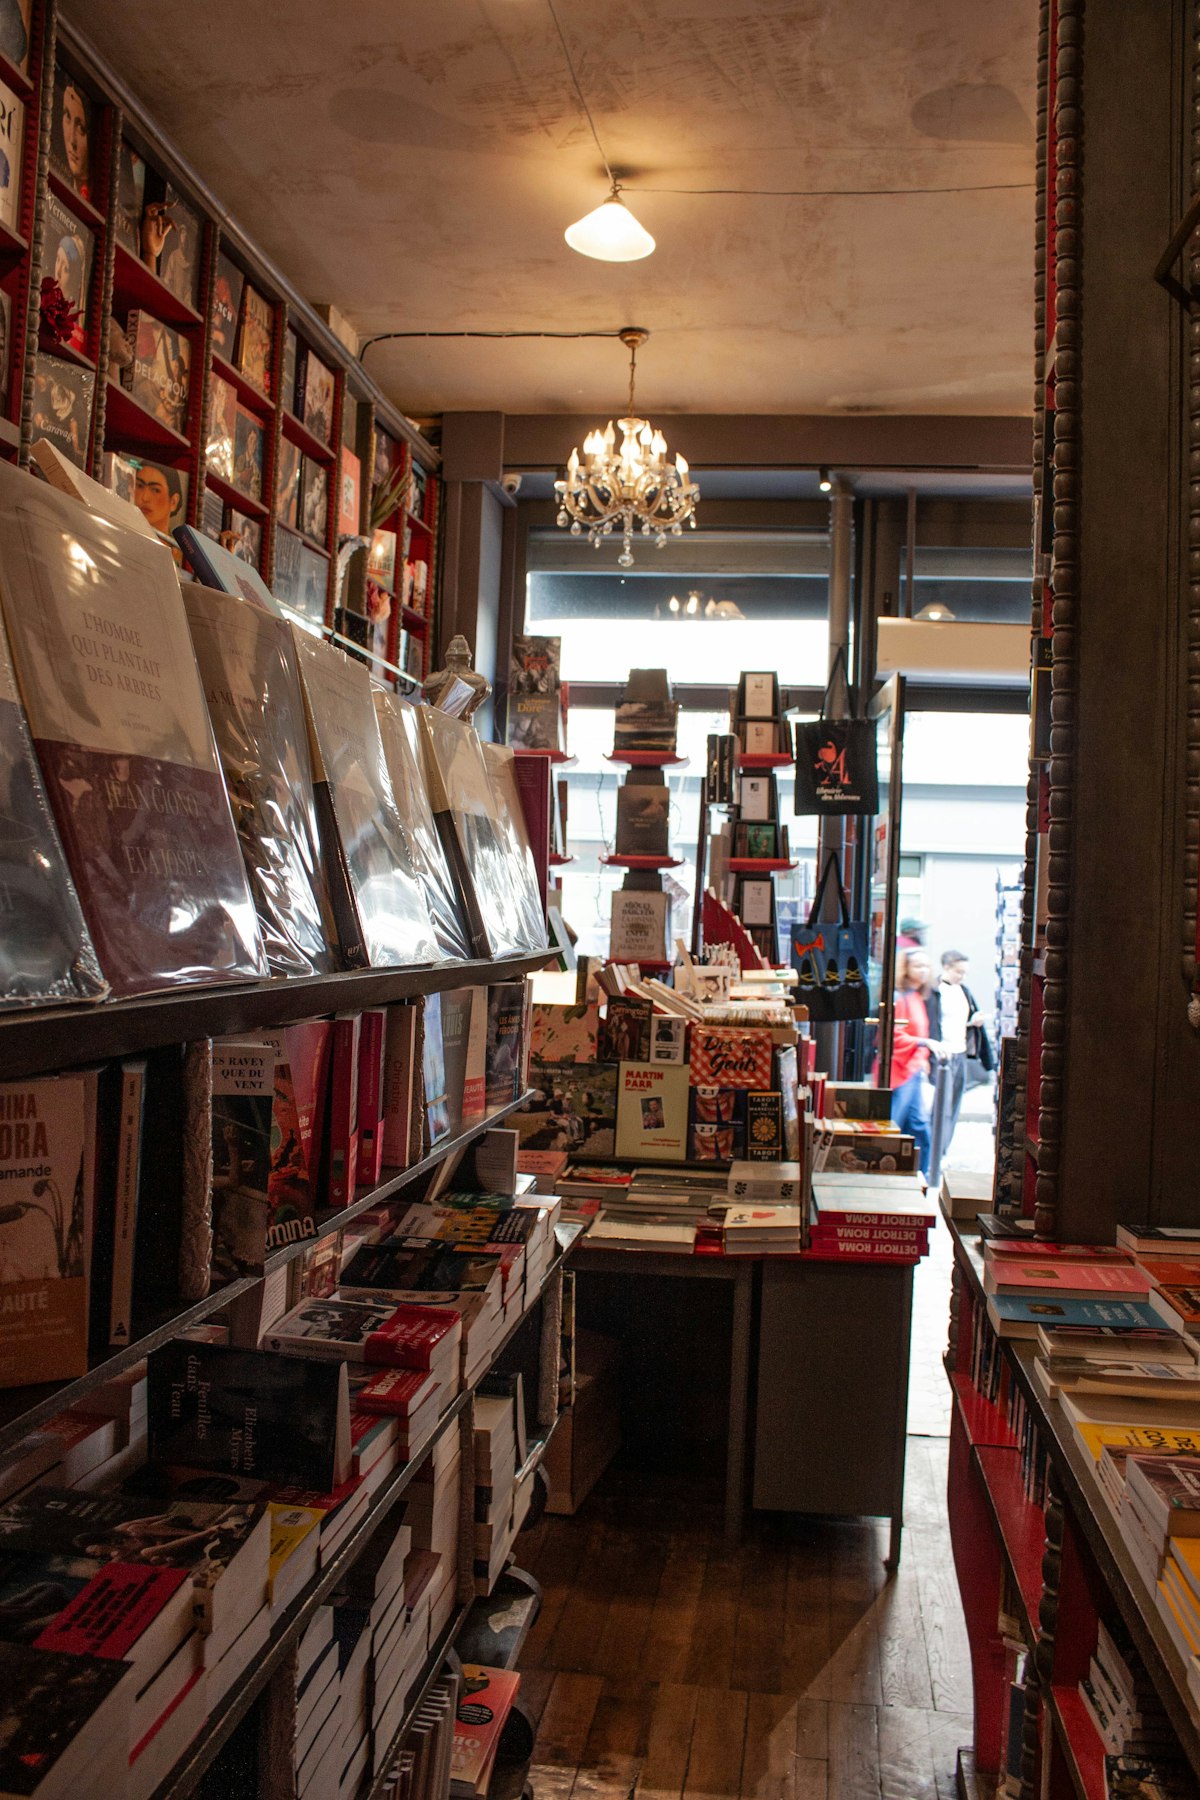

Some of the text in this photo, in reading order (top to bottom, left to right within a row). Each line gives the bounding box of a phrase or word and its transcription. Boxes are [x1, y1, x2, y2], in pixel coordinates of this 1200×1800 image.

[46, 195, 77, 234] Vermeer
[135, 360, 188, 399] DELACROIX
[40, 419, 75, 443] Caravag
[82, 611, 143, 648] L'HOMME
[71, 634, 161, 679] QUI PLANTAIT
[86, 664, 162, 702] DES ARBRES
[104, 779, 199, 817] JEAN GIONO
[124, 844, 161, 875] EVA
[229, 1057, 266, 1067] RAVEY
[703, 1036, 732, 1052] Des
[221, 1069, 265, 1079] QUE DU
[235, 1080, 265, 1089] VENT
[391, 1059, 403, 1115] Christine
[624, 1079, 653, 1089] PARR
[625, 1070, 664, 1080] MARTIN
[836, 1228, 917, 1241] DETROIT ROMA
[844, 1214, 925, 1227] DETROIT ROMA
[838, 1241, 918, 1255] DETROIT ROMA
[187, 1354, 202, 1393] dans
[170, 1382, 185, 1419] l'eau
[196, 1379, 213, 1440] Feuilles
[230, 1427, 243, 1470] Myers
[244, 1406, 257, 1472] Elizabeth
